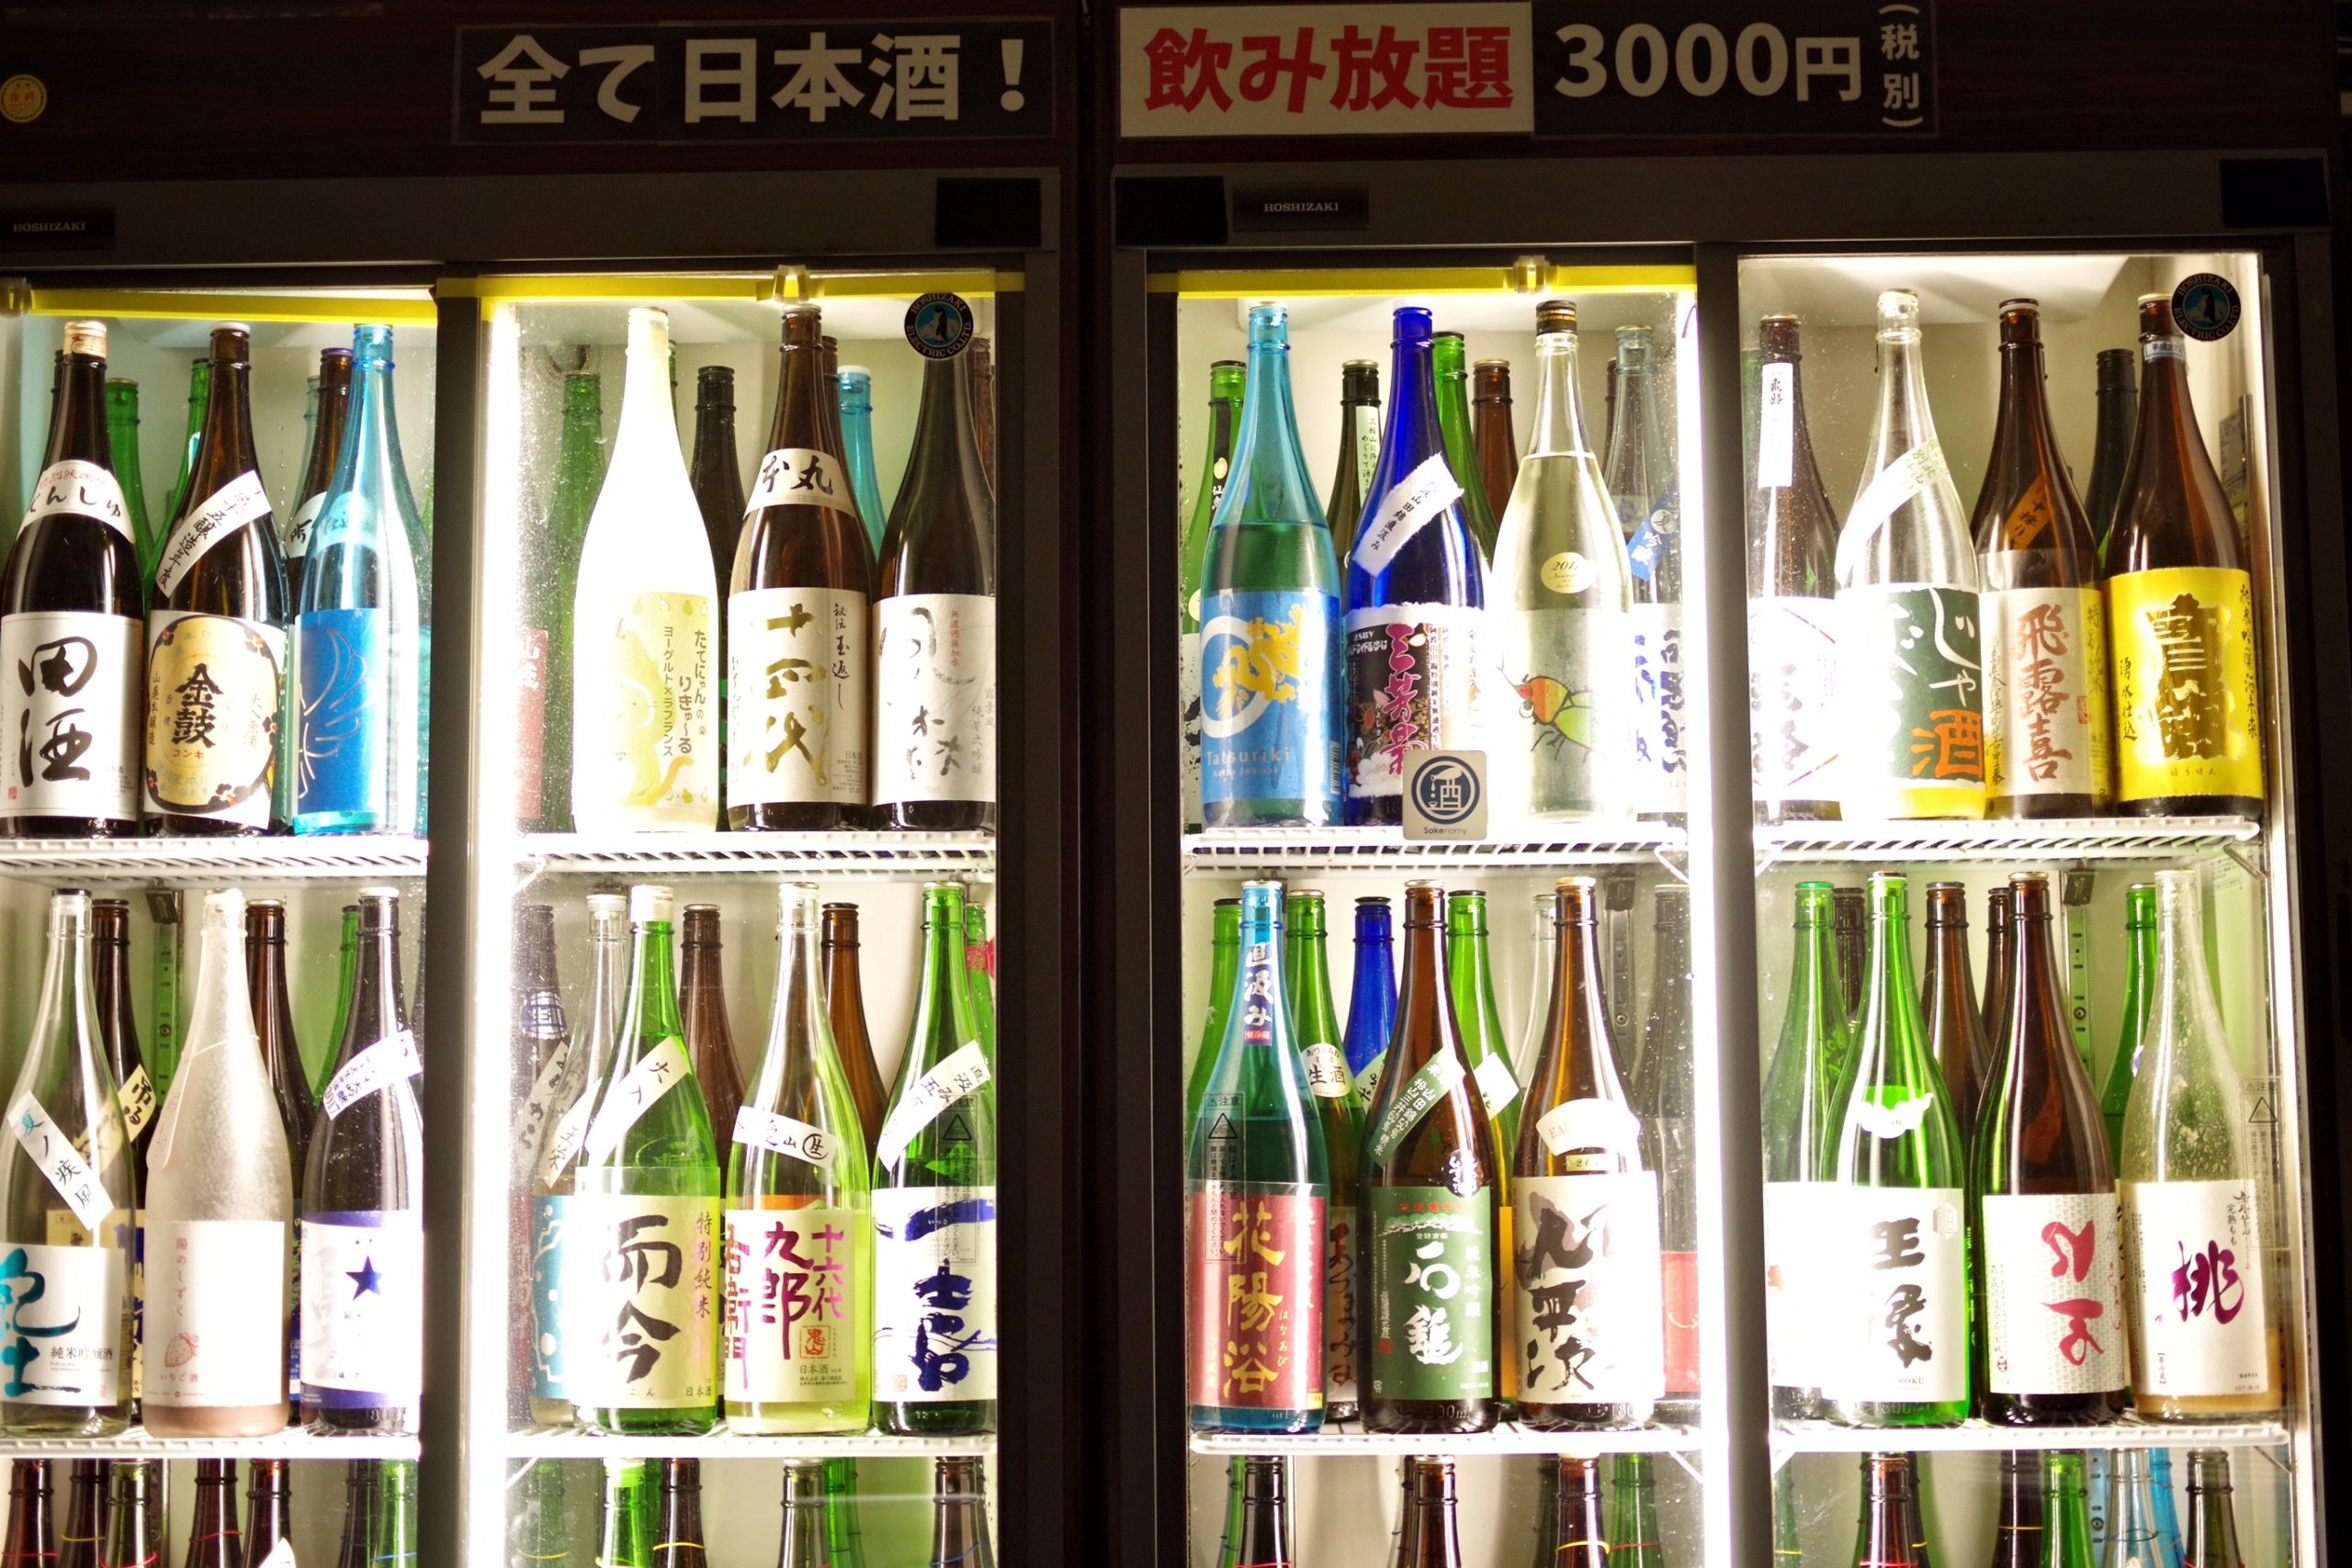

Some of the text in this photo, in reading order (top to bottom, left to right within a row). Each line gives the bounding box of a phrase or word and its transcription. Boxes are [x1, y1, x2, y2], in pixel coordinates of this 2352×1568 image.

[1143, 22, 1861, 113] 飲み放題 3000円
[13, 221, 87, 232] HOSHIZAKI
[1263, 201, 1340, 212] HOSHIZAKI
[910, 294, 967, 313] HOSHIZAKI
[2178, 276, 2233, 296] HOSHIZAKI
[763, 455, 834, 494] 本丸
[1553, 561, 1578, 571] 201
[18, 637, 97, 787] 田酒
[171, 663, 224, 749] 金鼓
[752, 604, 827, 785] 十四代
[2018, 604, 2073, 782] 飛露喜
[1424, 827, 1467, 836] Sakenomy
[1243, 944, 1273, 1027] 直汲み
[1308, 1065, 1347, 1086] 生酒
[603, 1215, 683, 1383] 而今
[695, 1212, 712, 1318] 特別純米
[761, 1221, 814, 1360] 九郎
[811, 1224, 846, 1322] 十六代
[1224, 1200, 1285, 1398] 花陽浴
[2171, 1240, 2245, 1325] 桃
[685, 1387, 712, 1397] 日本酒
